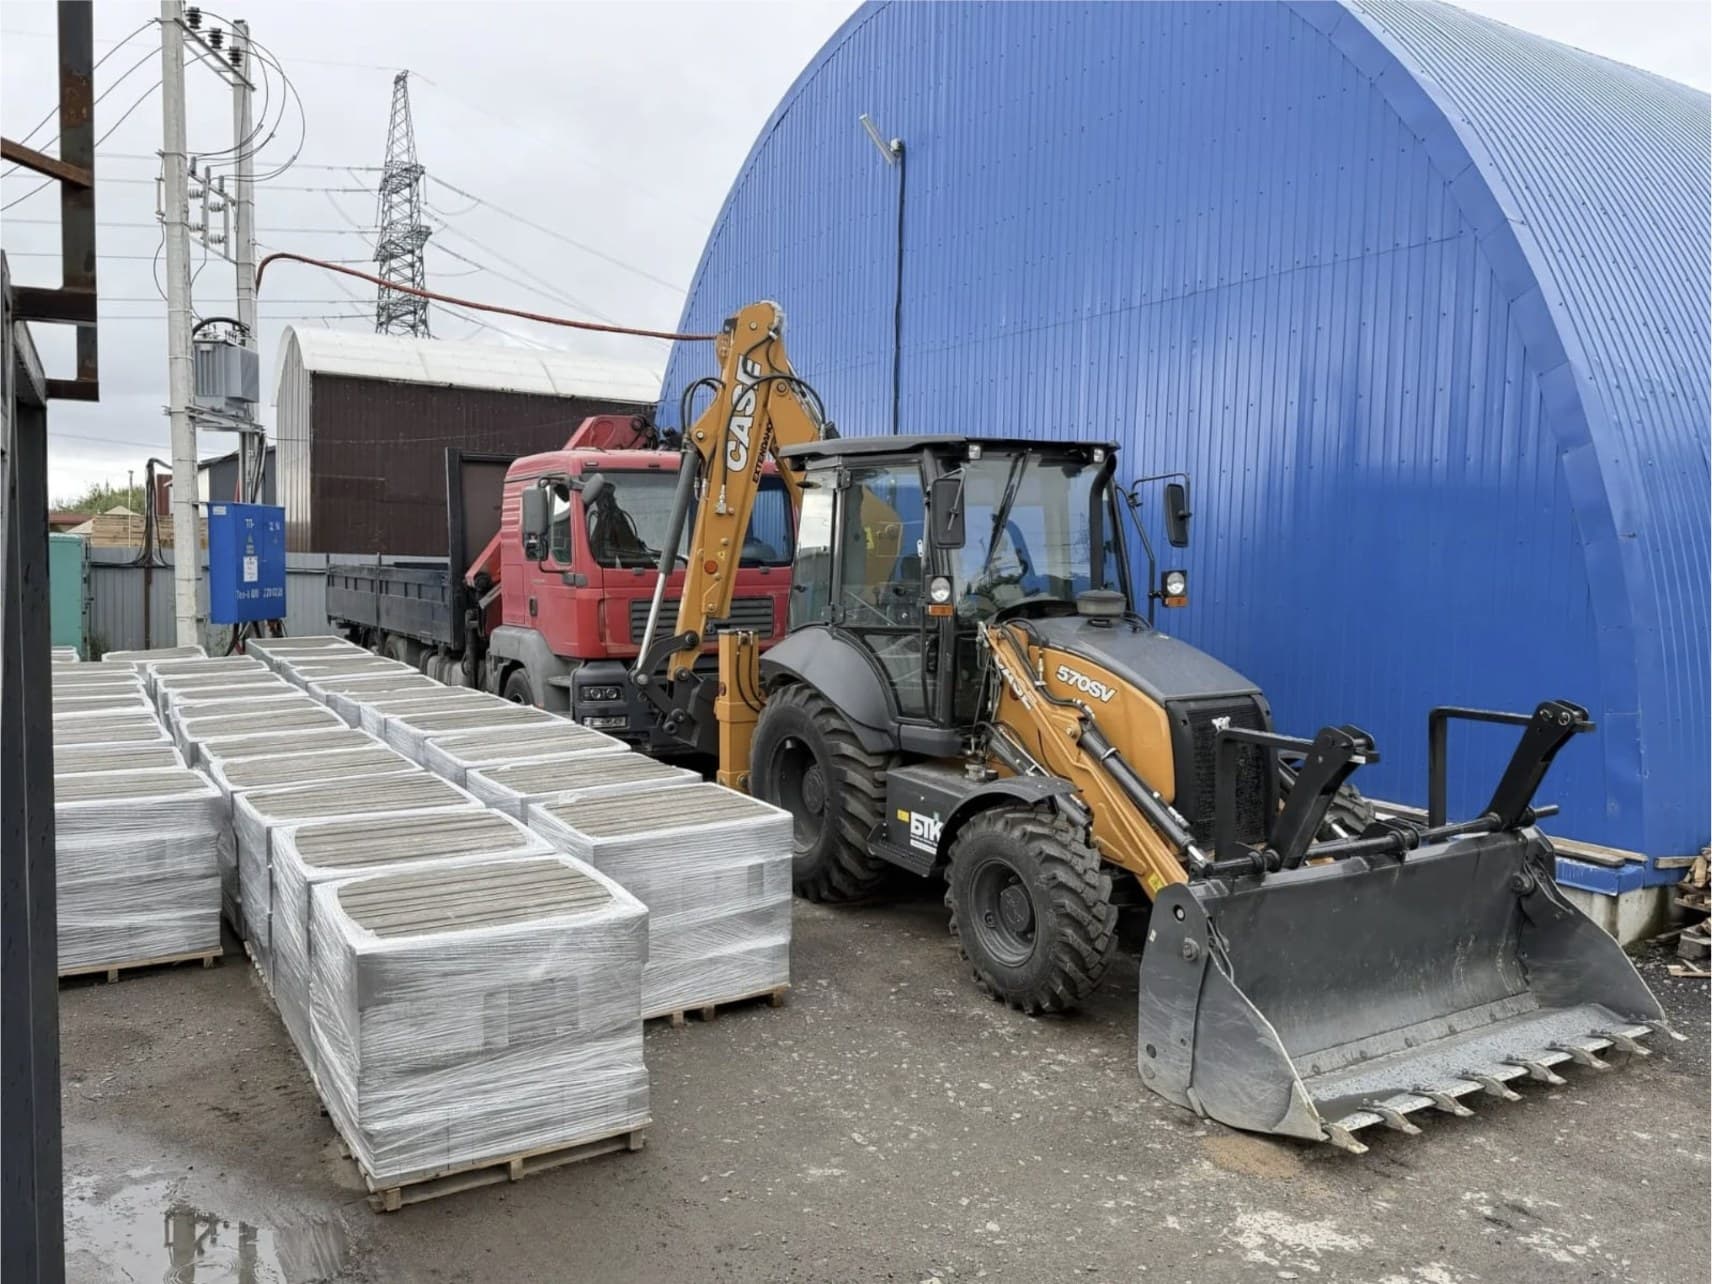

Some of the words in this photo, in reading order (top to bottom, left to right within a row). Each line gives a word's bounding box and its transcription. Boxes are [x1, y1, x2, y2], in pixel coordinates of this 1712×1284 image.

[727, 354, 761, 472] CASE
[753, 421, 774, 484] EXTENDAHO
[1056, 664, 1117, 703] 570SV
